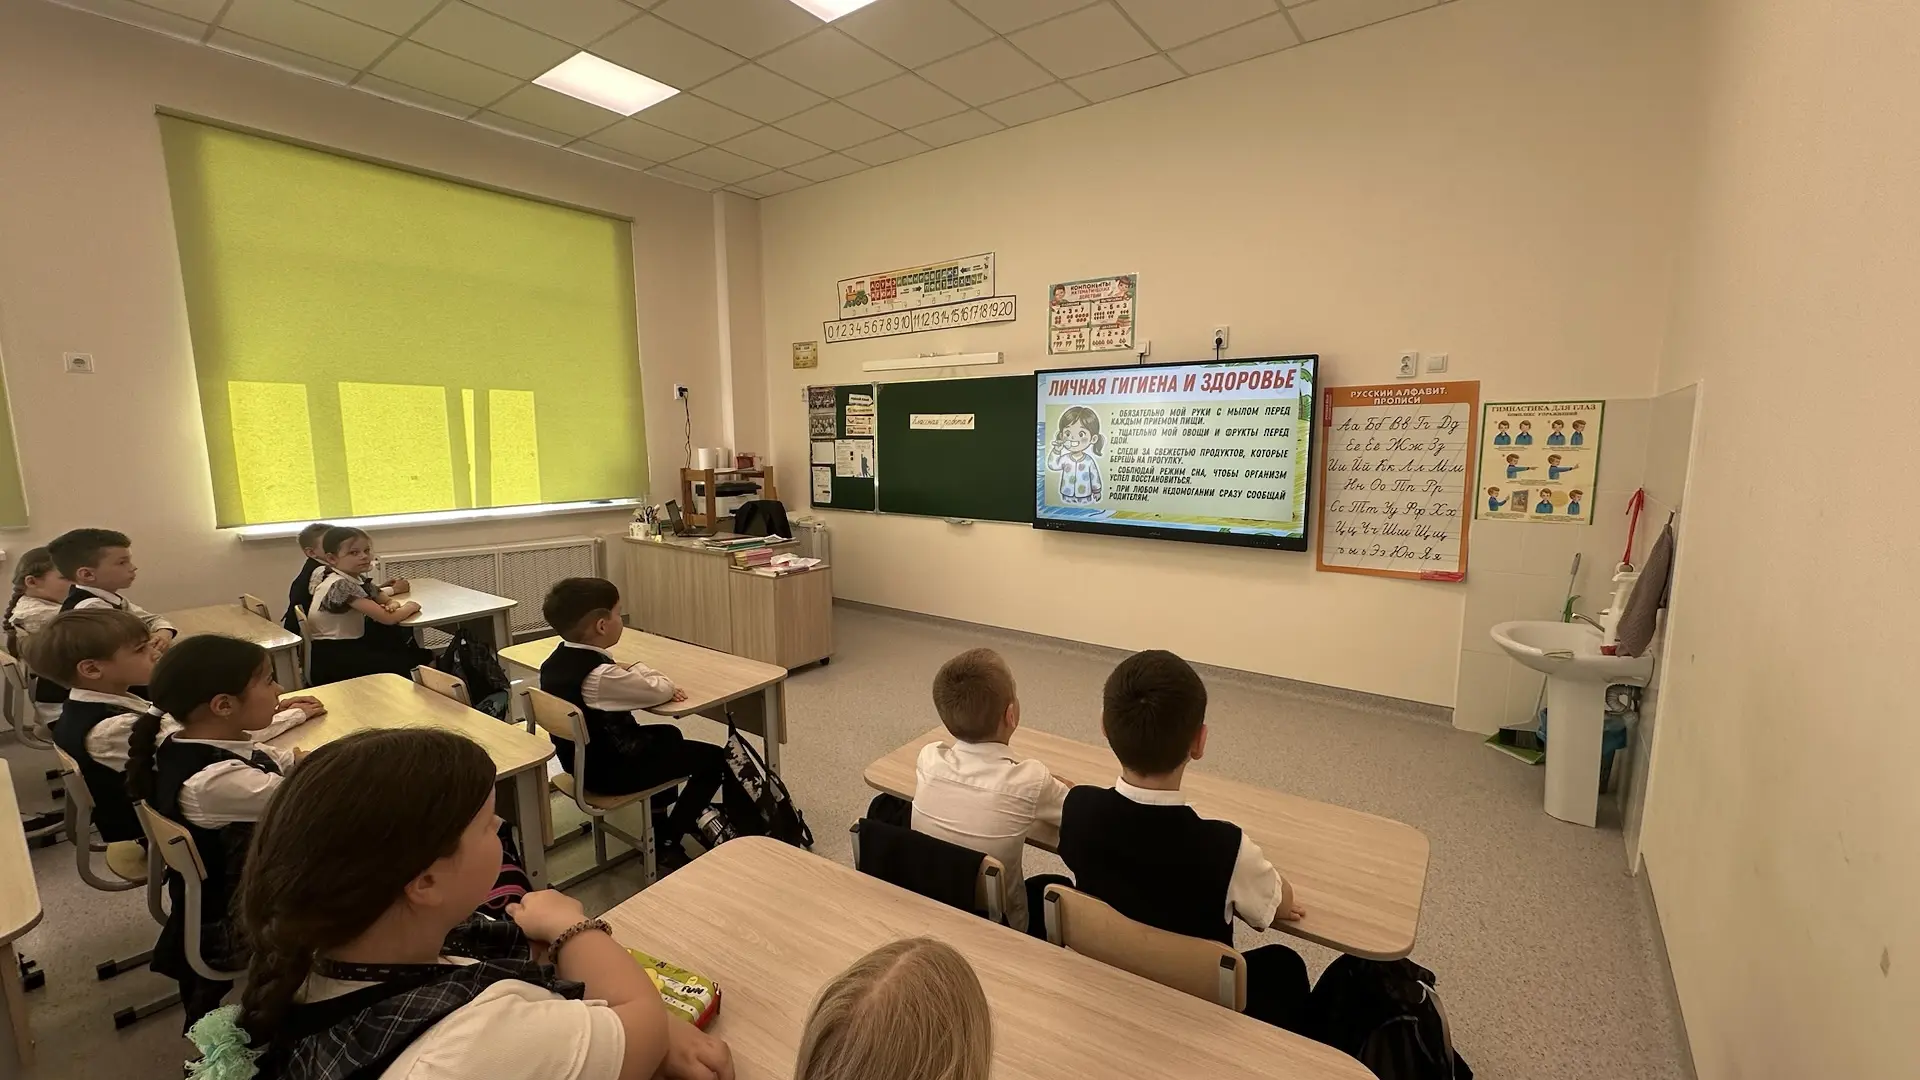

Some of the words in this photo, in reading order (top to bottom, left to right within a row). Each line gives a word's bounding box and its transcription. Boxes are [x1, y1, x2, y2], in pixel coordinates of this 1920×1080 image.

[1048, 378, 1107, 396] ЛИЧНАЯ
[1111, 374, 1177, 394] ГИГИЕНА
[1183, 374, 1196, 392] И
[1200, 369, 1297, 393] ЗДОРОВЬЕ
[1395, 387, 1448, 397] АЛФАВИТ.
[1374, 396, 1421, 405] ПРОПИСИ
[1120, 408, 1165, 417] ОБЯЗАТЕЛЬНО
[1170, 407, 1186, 416] МОЙ
[1191, 408, 1211, 416] РУКИ
[1216, 407, 1222, 416] С
[1227, 407, 1259, 416] МЫЛОМ
[1264, 406, 1291, 416] ПЕРЕД
[1144, 417, 1179, 425] ПРИЕМОМ
[1180, 417, 1205, 425] ПИЩИ.
[1336, 418, 1360, 431] Аа
[1365, 417, 1391, 430] Бб
[1389, 416, 1411, 431] Вв
[1414, 416, 1430, 429] Гг
[1437, 415, 1459, 434] Дд
[1118, 428, 1157, 436] ТЩАТЕЛЬНО
[1161, 427, 1178, 436] МОЙ
[1182, 428, 1209, 437] ОВОЩИ
[1214, 428, 1220, 436] И
[1225, 428, 1259, 436] ФРУКТЫ
[1263, 428, 1290, 437] ПЕРЕД
[1117, 448, 1138, 456] СЛЕДИ
[1154, 448, 1196, 456] СВЕЖЕСТЬЮ
[1200, 448, 1245, 458] ПРОДУКТОВ,
[1250, 449, 1288, 458] КОТОРЫЕ
[1346, 438, 1360, 451] Ее
[1386, 438, 1424, 451] Жж
[1428, 438, 1446, 456] Зз
[1147, 457, 1184, 465] ПРОГУЛКУ.
[1328, 458, 1348, 472] Ии
[1351, 456, 1372, 472] Йй
[1375, 459, 1395, 472] Кк
[1397, 459, 1425, 472] Лл
[1428, 459, 1464, 472] Мм
[1118, 466, 1155, 475] СОБЛЮДАЙ
[1160, 467, 1186, 476] РЕЖИМ
[1191, 468, 1206, 478] СНА,
[1213, 469, 1239, 478] ЧТОБЫ
[1244, 470, 1288, 479] ОРГАНИЗМ
[1109, 474, 1130, 482] УСПЕЛ
[1130, 475, 1192, 484] ВОССТАНОВИТЬСЯ.
[1133, 485, 1159, 494] ЛЮБОМ
[1163, 487, 1215, 496] НЕДОМОГАНИИ
[1219, 489, 1242, 498] СРАЗУ
[1246, 490, 1286, 500] СООБЩАЙ
[1344, 478, 1365, 490] Нн
[1370, 478, 1386, 491] Оо
[1391, 480, 1416, 492] Пп
[1422, 480, 1444, 496] Рр
[1109, 492, 1149, 501] РОДИТЕЛЯМ.
[1330, 500, 1344, 512] Сс
[1348, 501, 1379, 514] Тт
[1383, 501, 1399, 519] Уу
[1402, 501, 1425, 520] Фф
[1429, 503, 1456, 516] Хх
[1335, 521, 1358, 536] Цц
[1362, 522, 1379, 534] Чч
[1382, 523, 1410, 536] Шш
[1414, 524, 1448, 541] Щщ
[1370, 544, 1386, 556] Ээ
[1390, 545, 1414, 558] Юю
[1419, 547, 1442, 560] Яя
[681, 986, 704, 994] FUN
